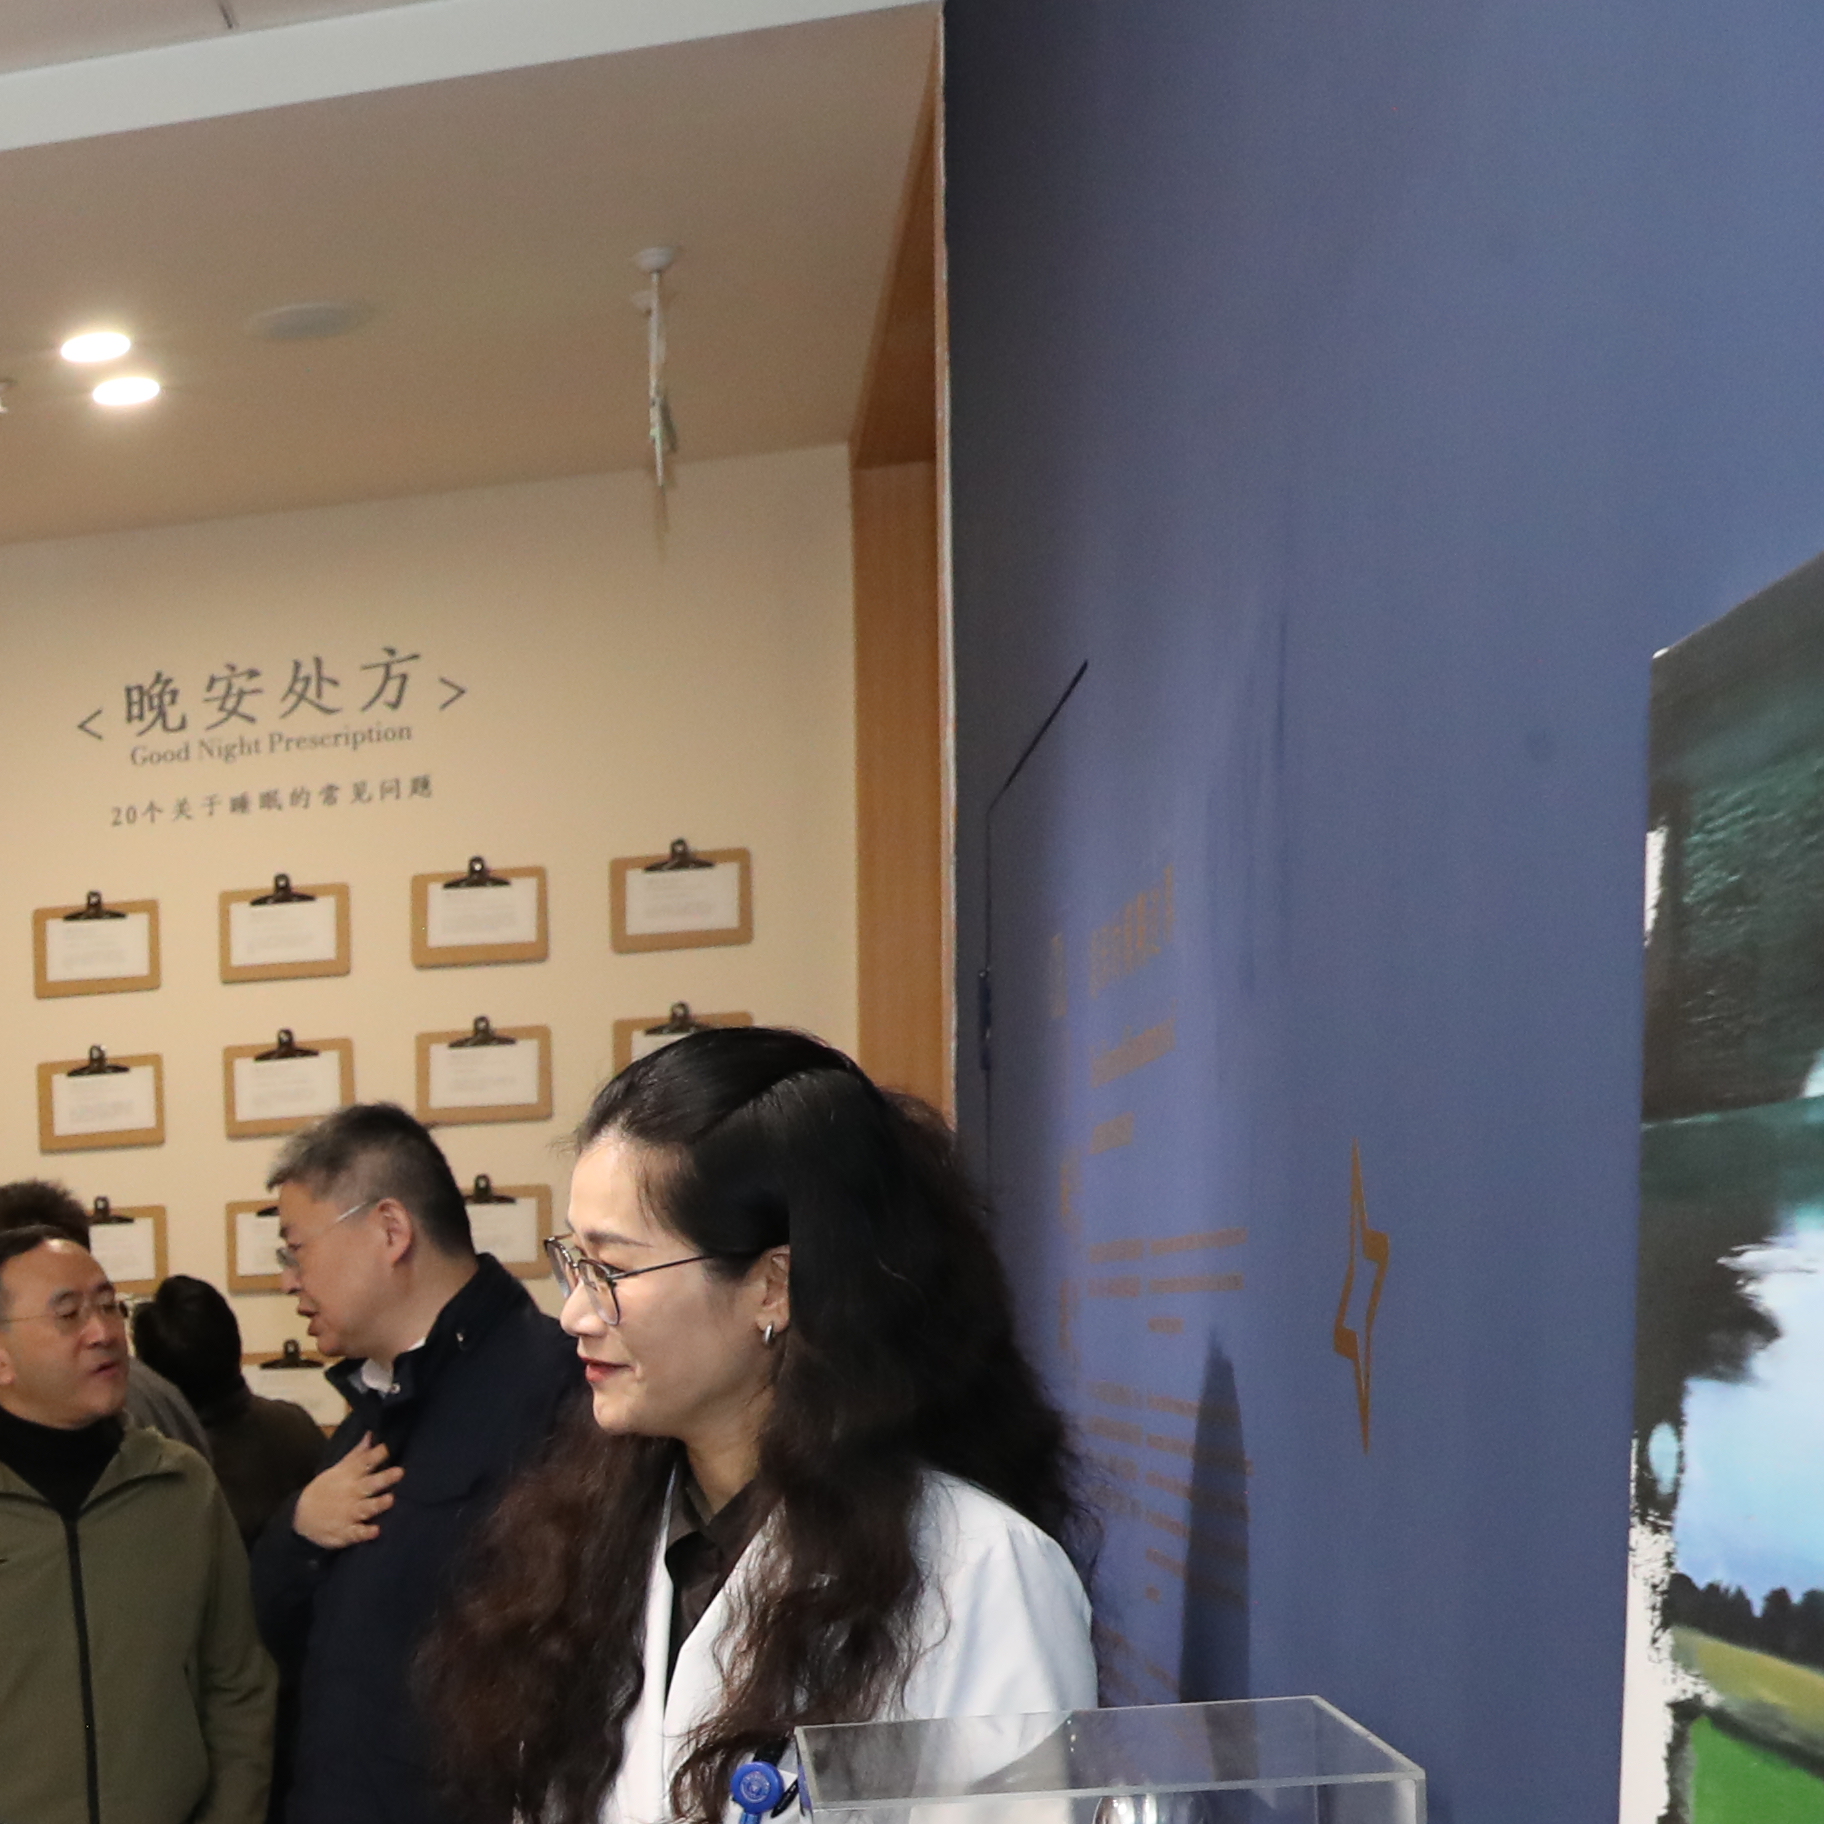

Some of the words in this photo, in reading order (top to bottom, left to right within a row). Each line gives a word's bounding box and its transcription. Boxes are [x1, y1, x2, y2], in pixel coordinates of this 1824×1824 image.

[130, 742, 190, 766] Good
[197, 735, 261, 764] Night
[268, 720, 414, 756] Prescription
[110, 773, 434, 828] 20个关于睡眠的常见问题
